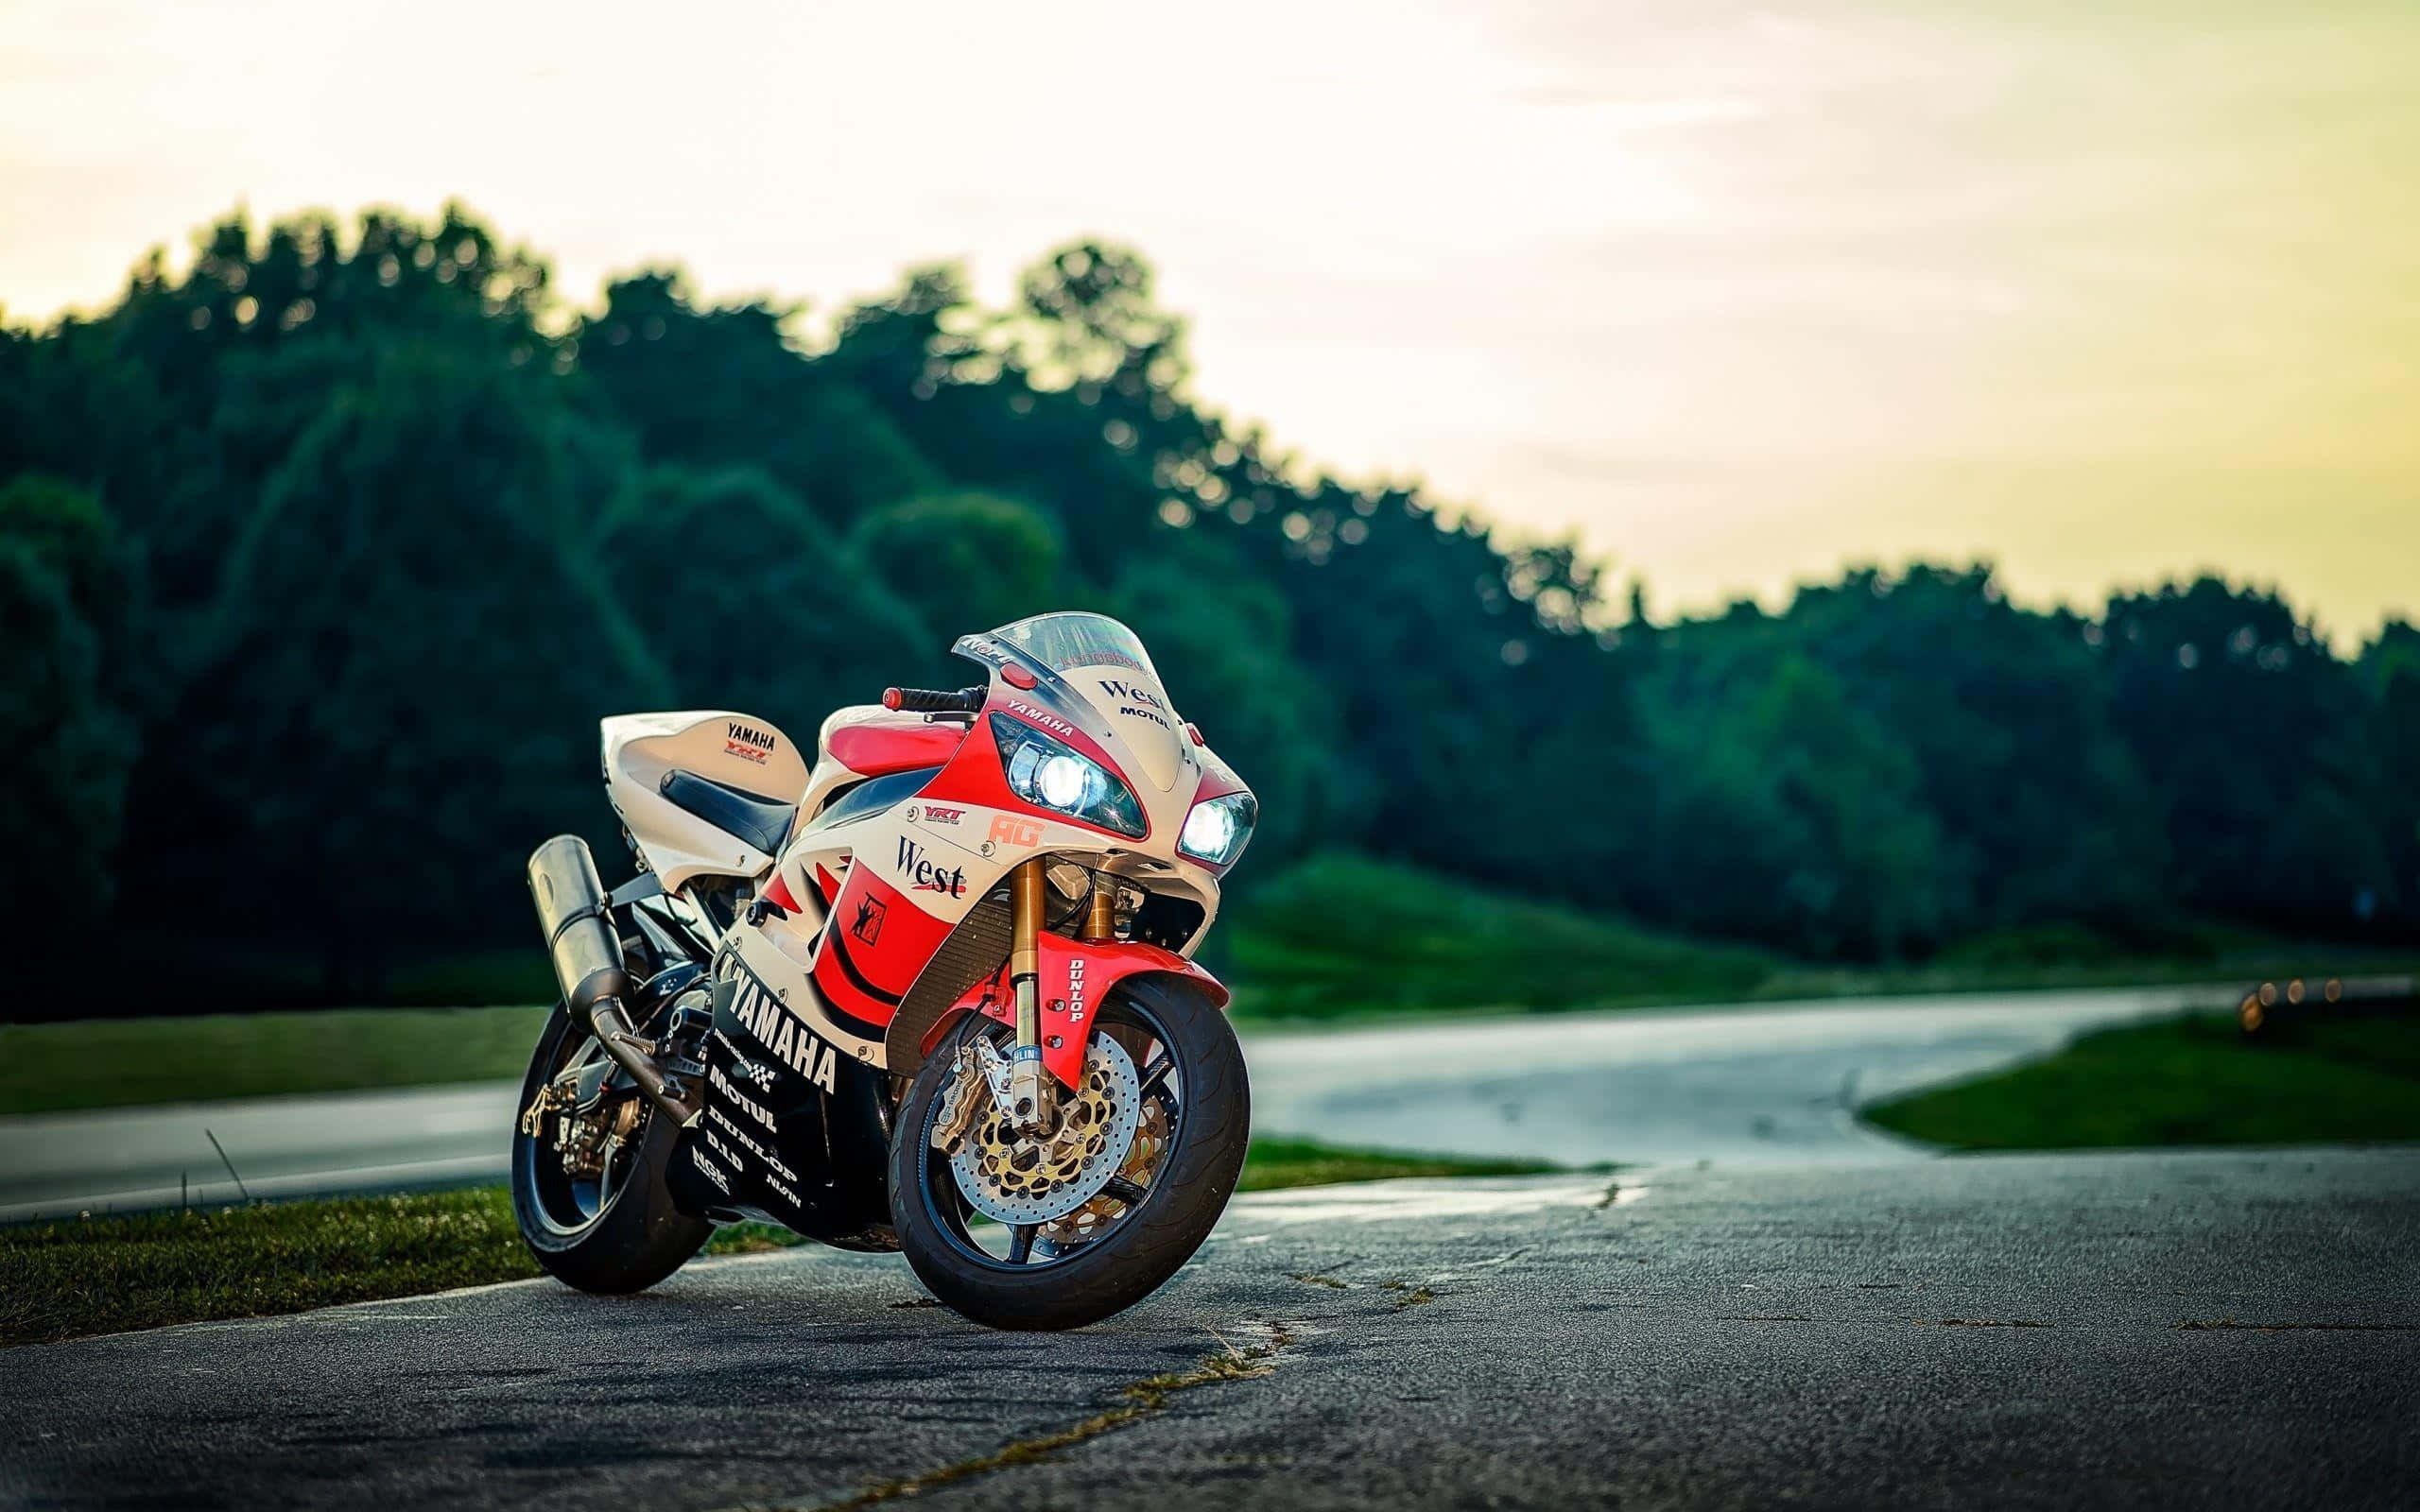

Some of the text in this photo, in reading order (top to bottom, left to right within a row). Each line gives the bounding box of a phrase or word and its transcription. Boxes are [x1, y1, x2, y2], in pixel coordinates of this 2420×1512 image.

[728, 722, 775, 752] YAMAHA
[1008, 699, 1074, 737] YAMAHA
[1120, 707, 1170, 731] MOTUL
[925, 805, 966, 820] YRT
[897, 834, 961, 900] West
[1069, 959, 1084, 1022] DUNLOP
[729, 966, 837, 1095] YAMAHA
[709, 1064, 777, 1134] MOTUL
[692, 1144, 729, 1192] NGK
[708, 1105, 798, 1182] DUNLOP
